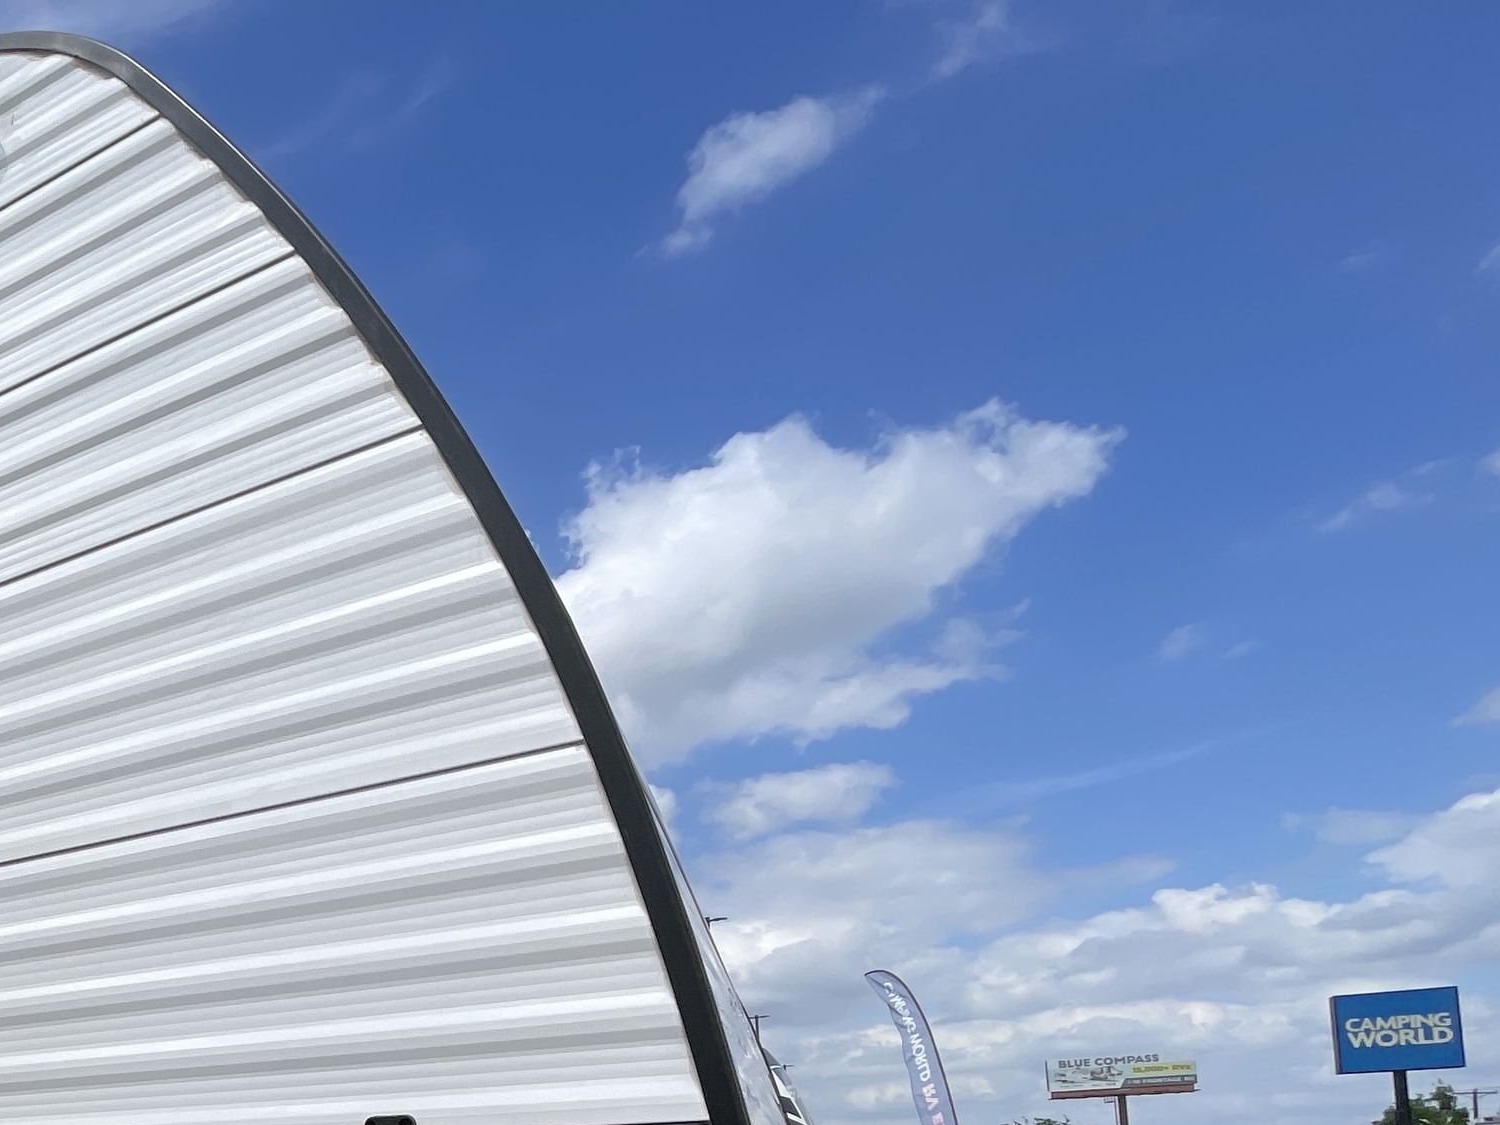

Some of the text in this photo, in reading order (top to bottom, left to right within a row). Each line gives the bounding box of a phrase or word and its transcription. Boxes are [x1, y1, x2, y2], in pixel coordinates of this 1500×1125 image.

[1345, 1012, 1452, 1032] CAMPING
[1347, 1026, 1454, 1049] WORLD
[1058, 1053, 1160, 1069] BLUE COMPASS
